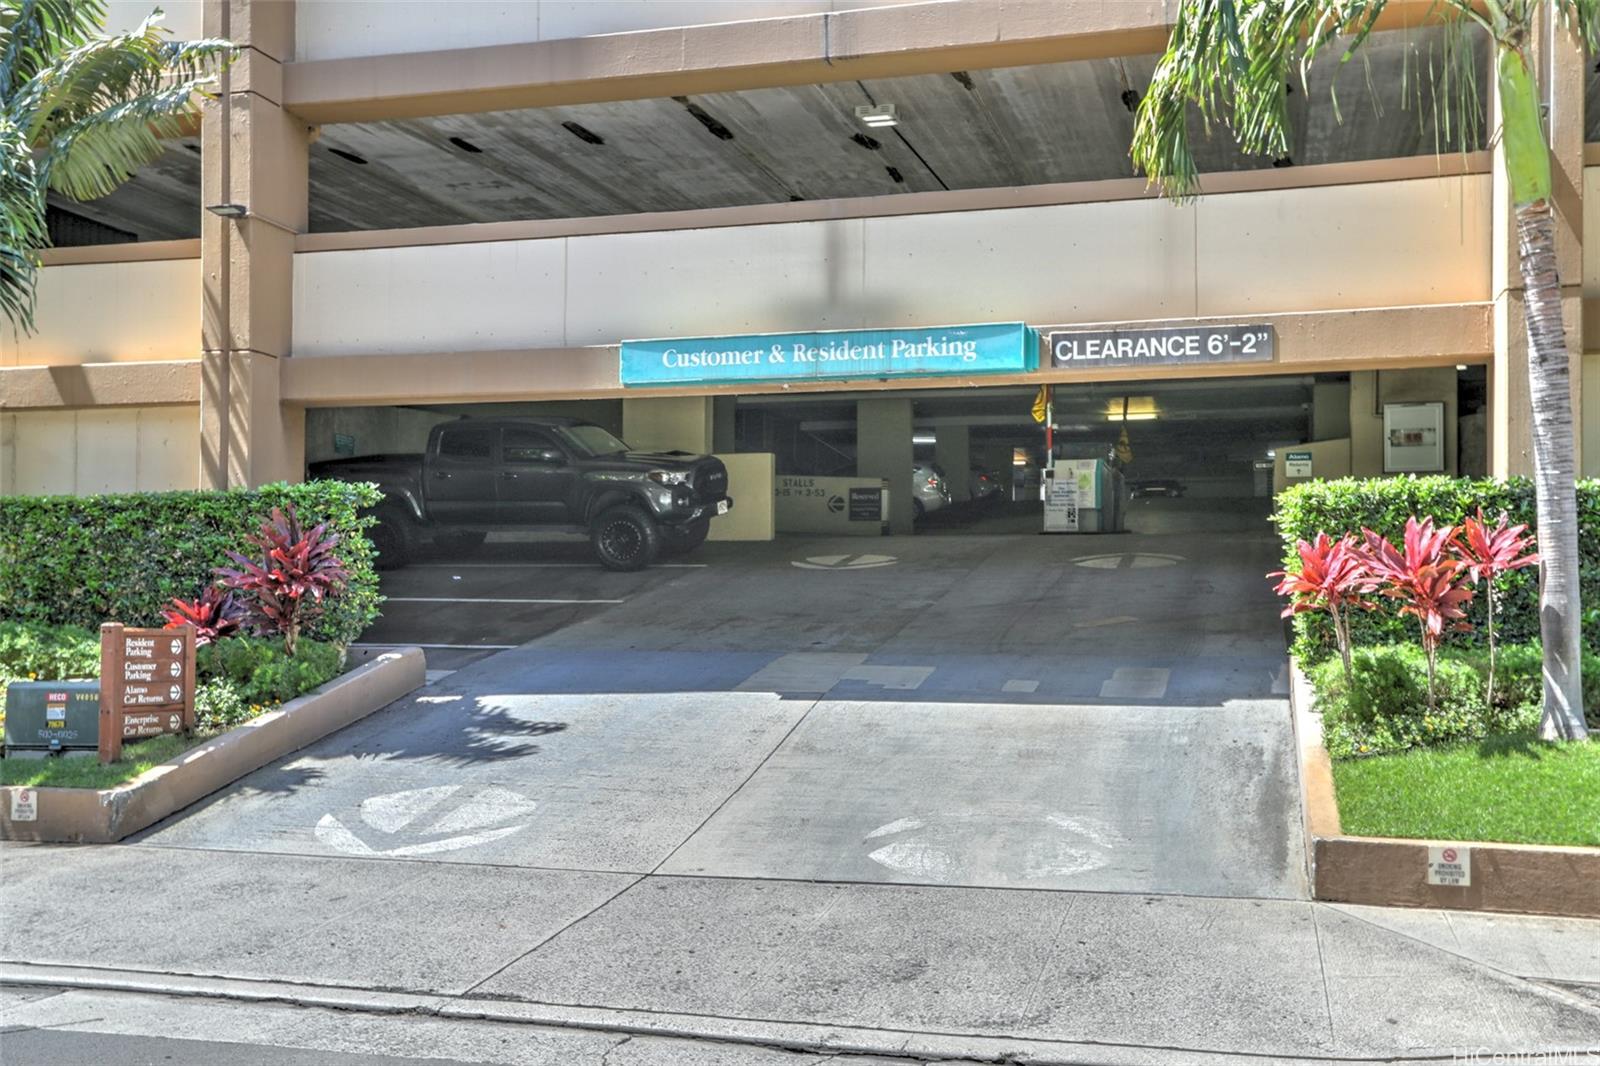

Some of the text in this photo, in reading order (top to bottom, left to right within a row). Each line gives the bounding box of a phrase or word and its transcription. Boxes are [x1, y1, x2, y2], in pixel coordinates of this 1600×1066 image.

[661, 336, 977, 369] Customer & Resident Parking
[1055, 335, 1201, 361] CLEARANCE
[783, 478, 815, 488] STALLS
[125, 637, 155, 647] Resident
[125, 647, 152, 658] Parking
[124, 661, 157, 671] Customer
[124, 670, 152, 681] Parking
[124, 685, 148, 694] Alamo
[48, 693, 67, 701] HECO
[123, 694, 163, 704] Car Returns
[124, 714, 160, 726] Enterprise
[123, 725, 163, 735] Car Returns
